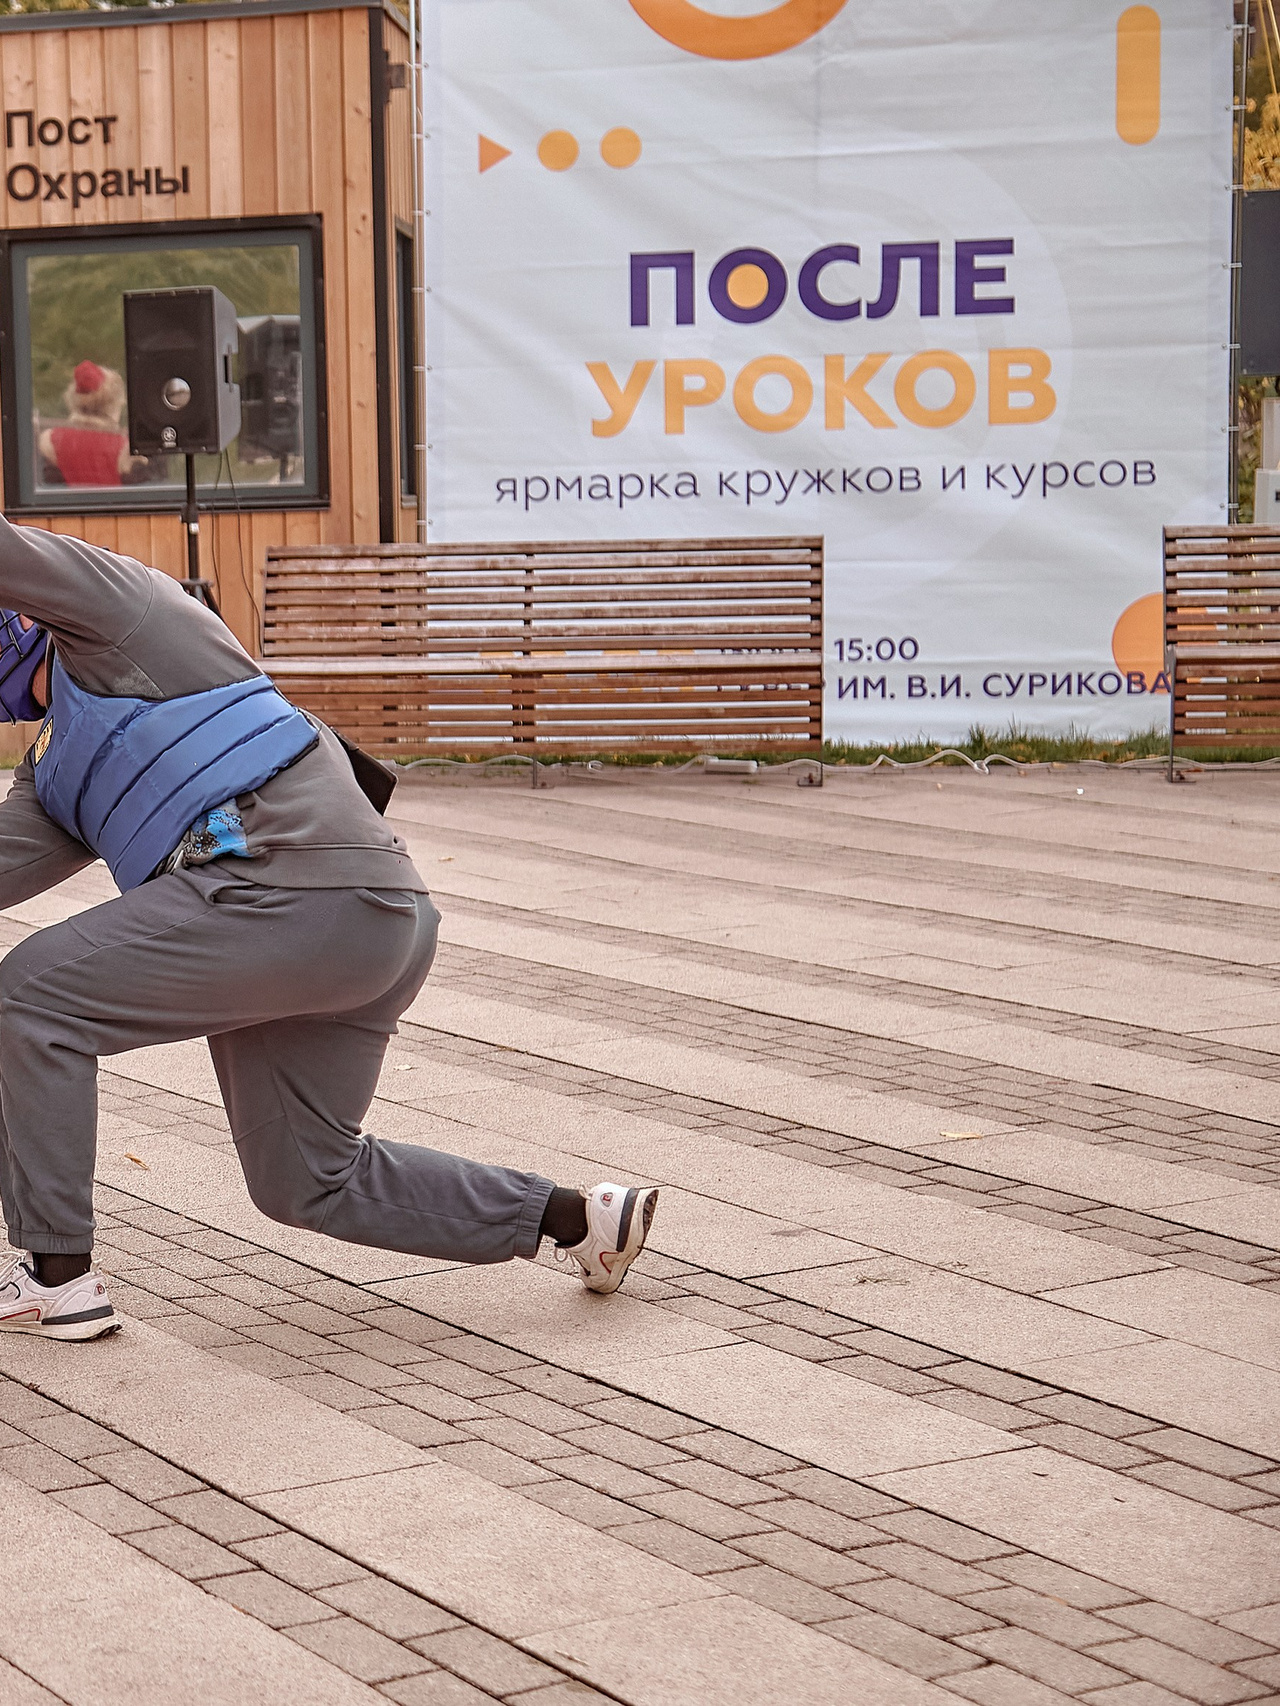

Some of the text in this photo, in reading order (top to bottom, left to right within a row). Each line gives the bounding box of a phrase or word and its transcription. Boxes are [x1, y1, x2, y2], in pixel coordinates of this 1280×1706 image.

[4, 110, 118, 149] Пост
[5, 162, 191, 209] Охраны
[629, 237, 1016, 328] ПОСЛЕ
[586, 347, 1058, 438] УРОКОВ
[495, 459, 1158, 512] ярмарка кружков и курсов
[833, 637, 920, 664] 15:00
[837, 675, 896, 700] ИМ.
[907, 673, 972, 699] В.И.
[983, 671, 1172, 698] СУРИКОВА
